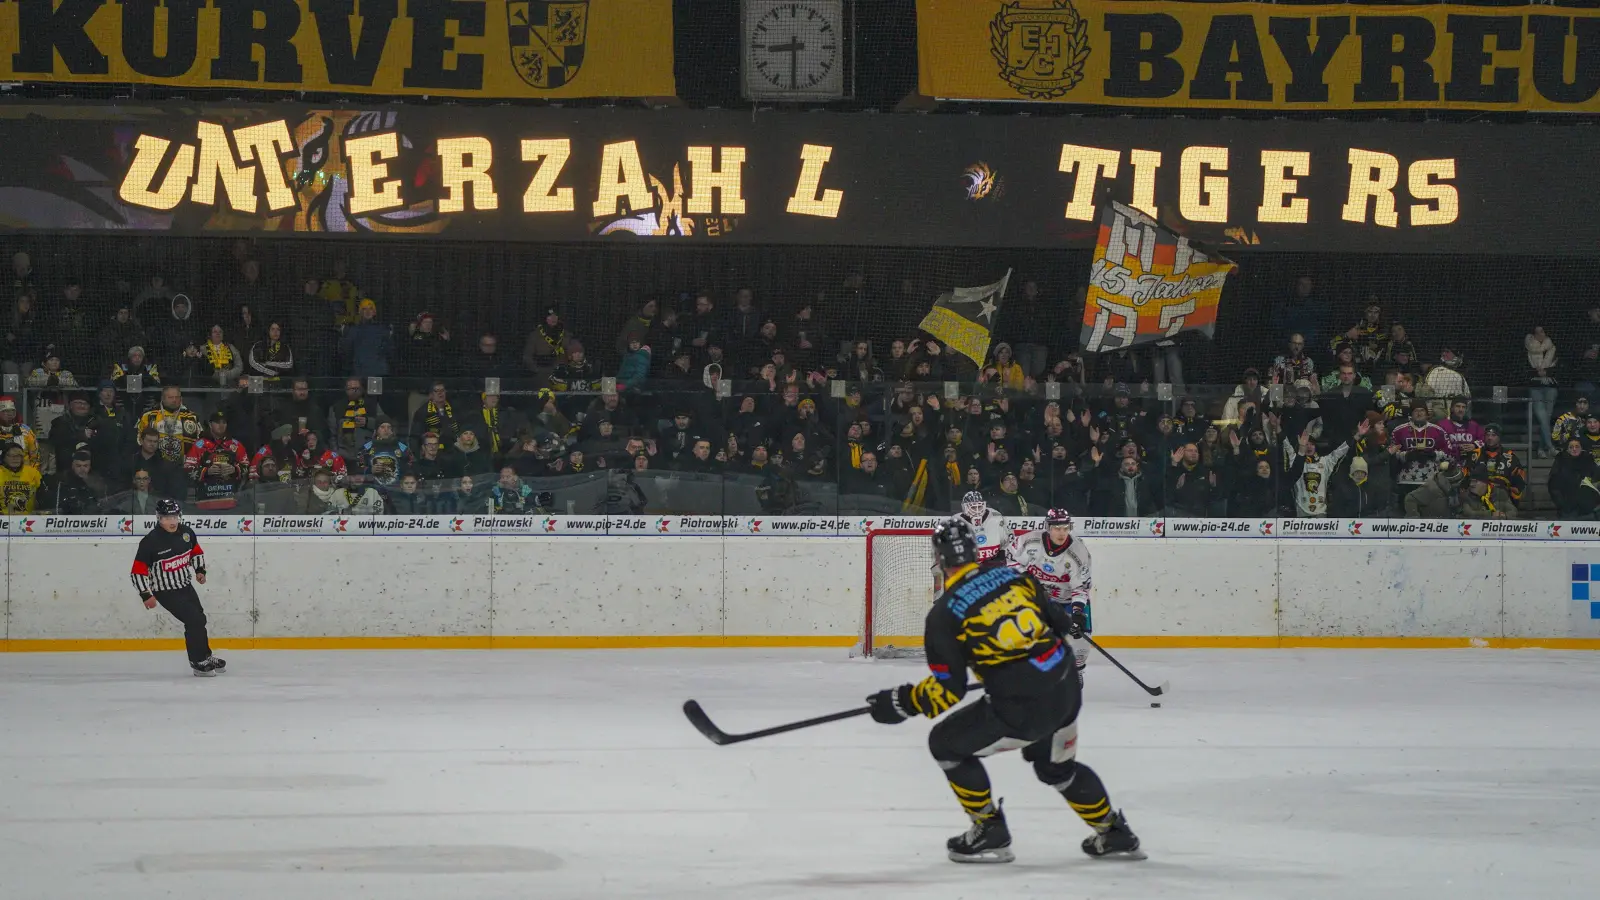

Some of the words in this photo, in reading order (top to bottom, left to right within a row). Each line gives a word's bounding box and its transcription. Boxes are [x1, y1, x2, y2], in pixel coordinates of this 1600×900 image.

[12, 0, 486, 90] KURVE
[1103, 13, 1600, 104] BAYREU
[1059, 143, 1459, 228] TIGERS
[45, 517, 108, 528] Piotrowski
[263, 517, 323, 528] Piotrowski
[358, 518, 440, 531] www.pio-24.de
[474, 517, 533, 528] Piotrowski
[567, 519, 646, 531] www.pio-24.de
[680, 518, 738, 528] Piotrowski
[772, 519, 850, 531] www.pio-24.de
[1084, 519, 1140, 530] Piotrowski
[1173, 521, 1250, 533] www.pio-24.de
[1283, 520, 1339, 531] Piotrowski
[1372, 522, 1448, 534] www.pio-24.de
[1481, 522, 1538, 532] Piotrowski
[1571, 525, 1600, 537] www.
